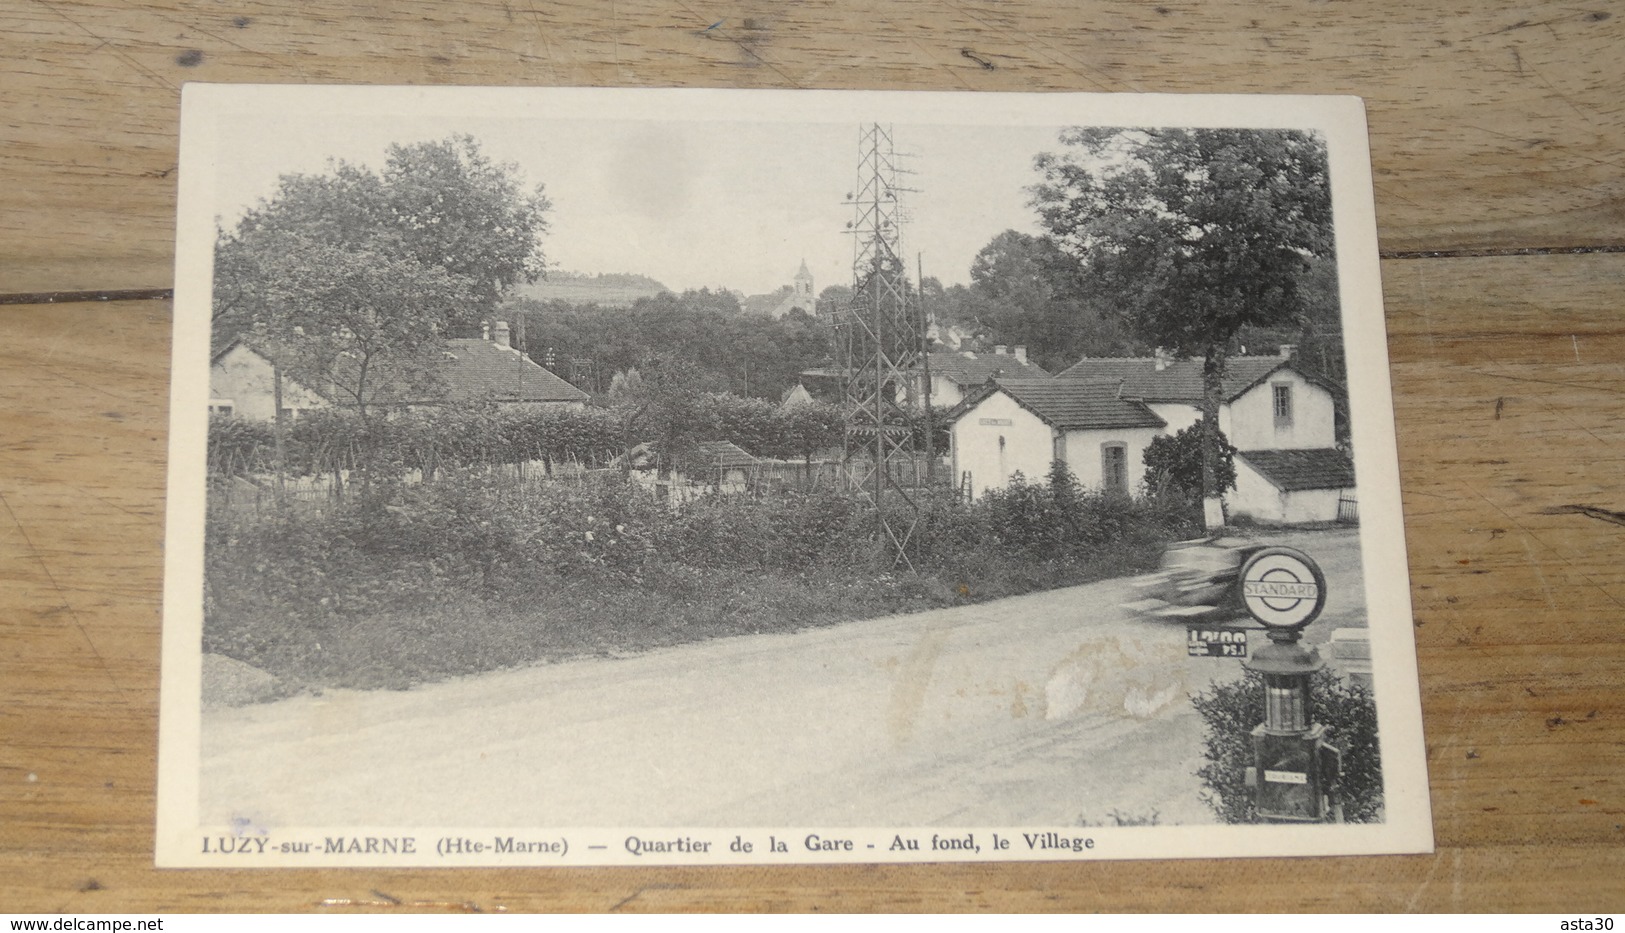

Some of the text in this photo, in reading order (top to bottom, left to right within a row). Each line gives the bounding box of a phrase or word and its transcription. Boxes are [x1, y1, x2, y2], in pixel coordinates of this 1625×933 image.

[1244, 583, 1317, 597] STANDARD
[202, 838, 416, 853] LUZY-sur-MARNE
[436, 838, 569, 855] (Hte-Marne)
[624, 837, 712, 855] Quartier
[730, 836, 753, 852] de
[770, 836, 788, 852] la
[804, 835, 853, 851] Gare
[889, 835, 920, 851] Au
[932, 833, 981, 853] fond,
[993, 834, 1010, 850] le
[1023, 832, 1095, 853] Village
